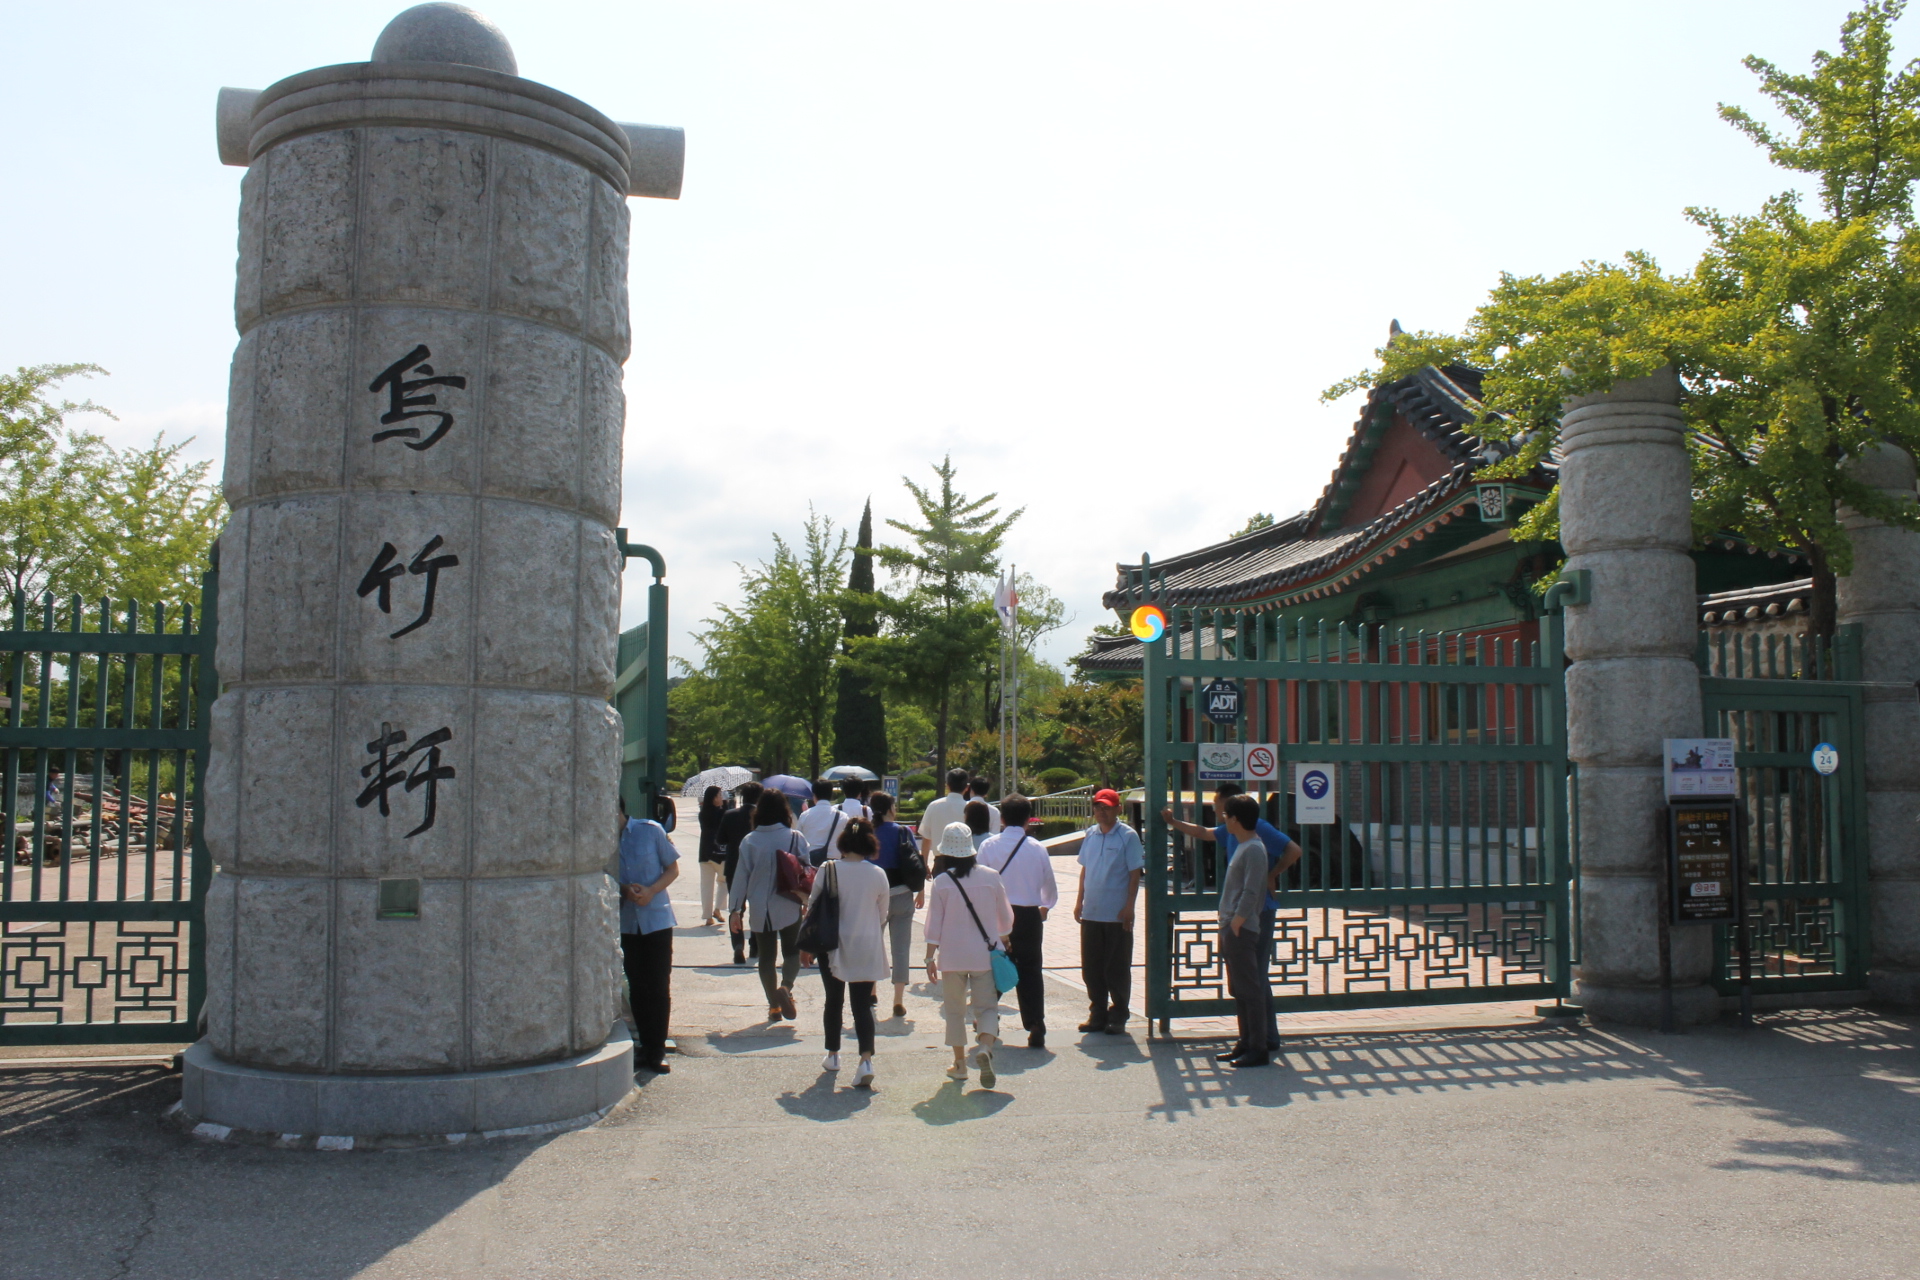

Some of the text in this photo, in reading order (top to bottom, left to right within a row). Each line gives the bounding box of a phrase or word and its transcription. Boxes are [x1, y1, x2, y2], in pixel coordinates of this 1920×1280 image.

[356, 344, 466, 839] 烏竹軒
[1210, 695, 1237, 709] ADT
[1820, 755, 1832, 765] 24
[1703, 883, 1716, 892] 금연
